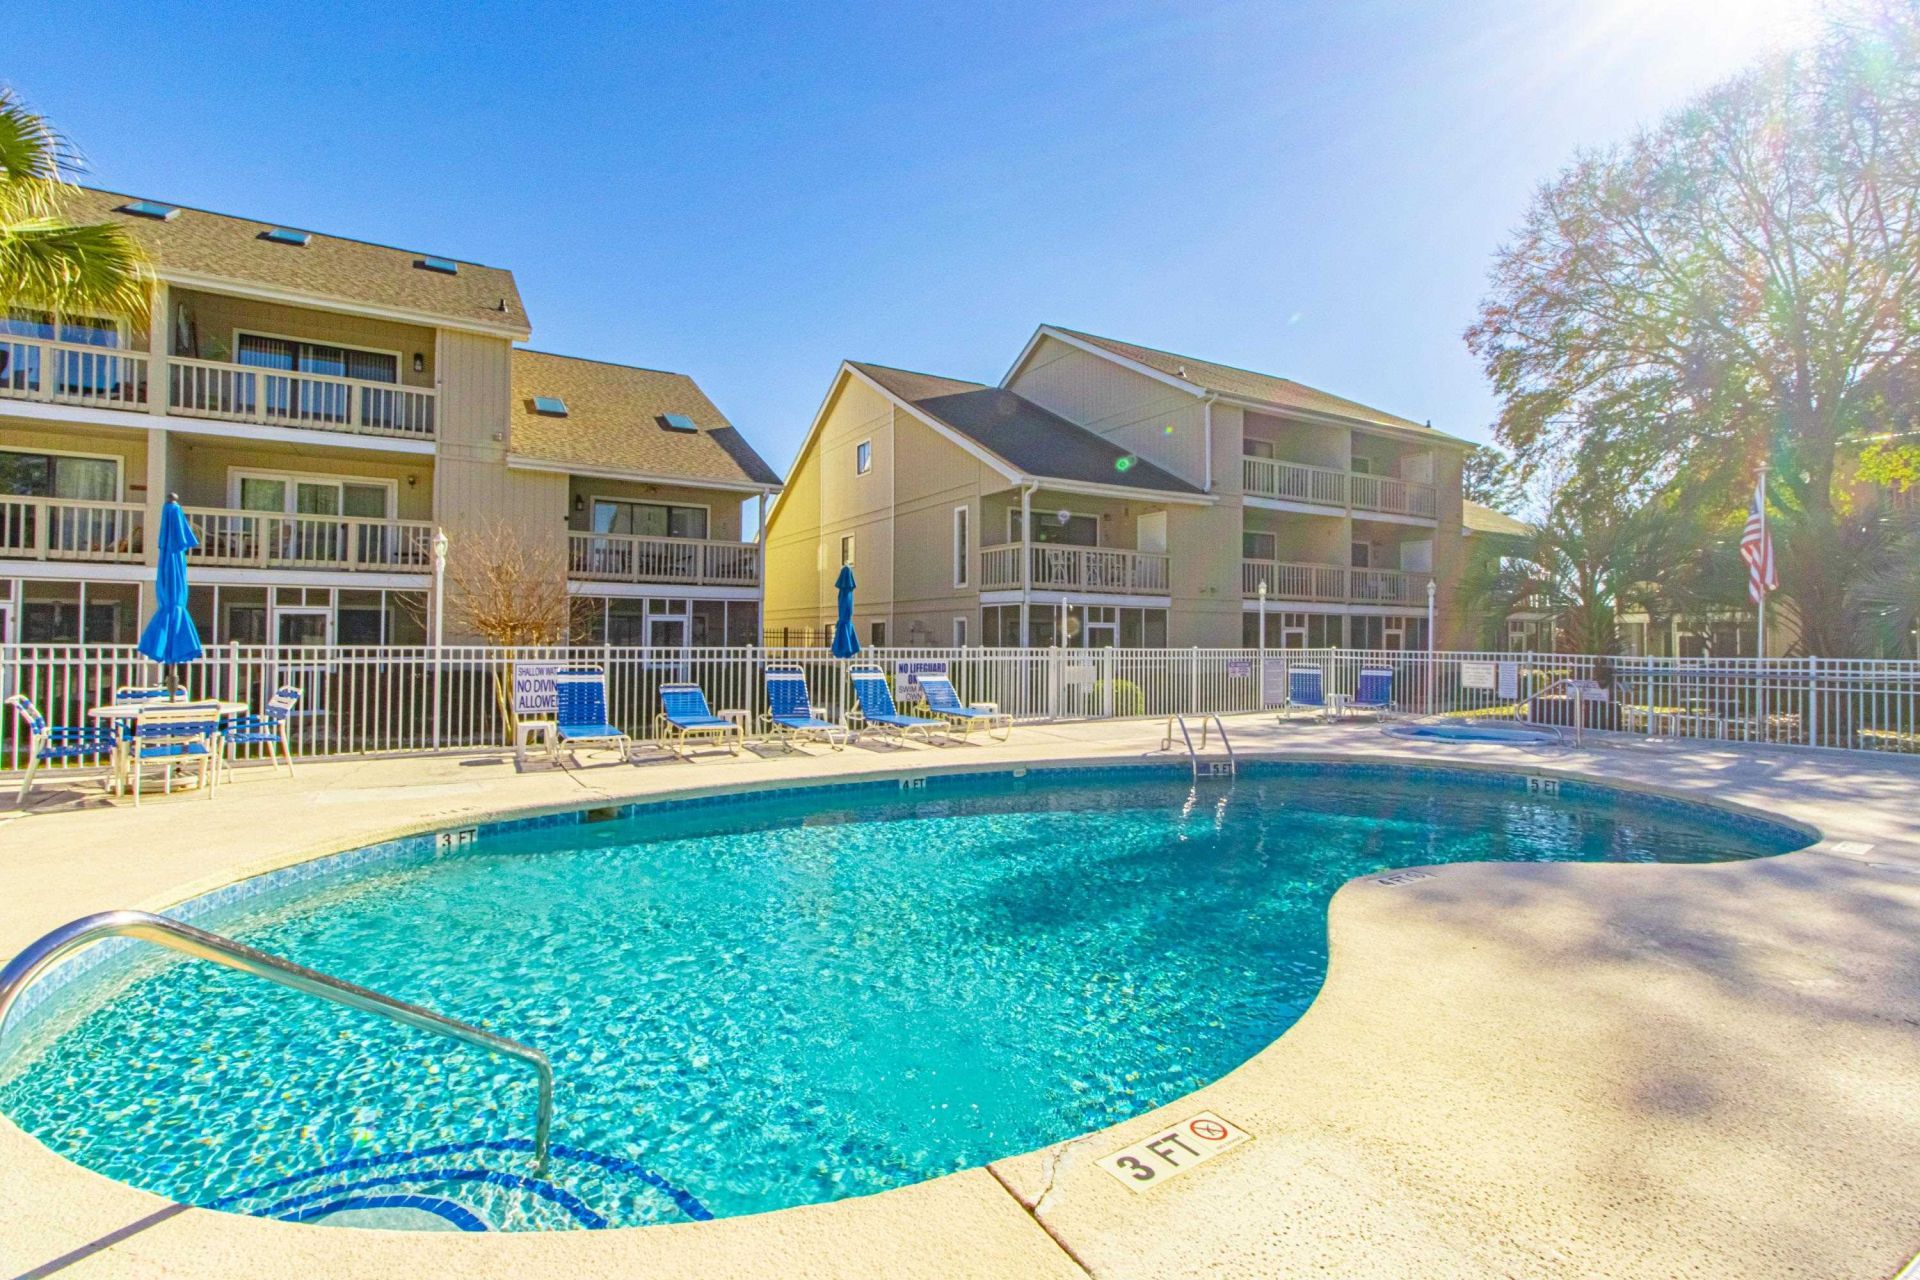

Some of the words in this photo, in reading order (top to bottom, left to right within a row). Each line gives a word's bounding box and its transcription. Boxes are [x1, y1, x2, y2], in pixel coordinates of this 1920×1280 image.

[518, 667, 544, 676] SHALLOW
[898, 663, 908, 673] NO
[910, 662, 946, 673] LIFEGUARD
[517, 680, 531, 692] NO
[533, 679, 558, 692] DIVIN
[519, 695, 555, 708] ALLOWE
[1213, 764, 1219, 775] 5
[902, 780, 909, 789] 4
[914, 778, 925, 789] FT
[1531, 779, 1539, 790] 5
[1545, 780, 1557, 790] FT
[442, 833, 452, 848] 3
[459, 829, 476, 845] FT
[1116, 1156, 1156, 1181] 3
[1146, 1132, 1200, 1167] FT
